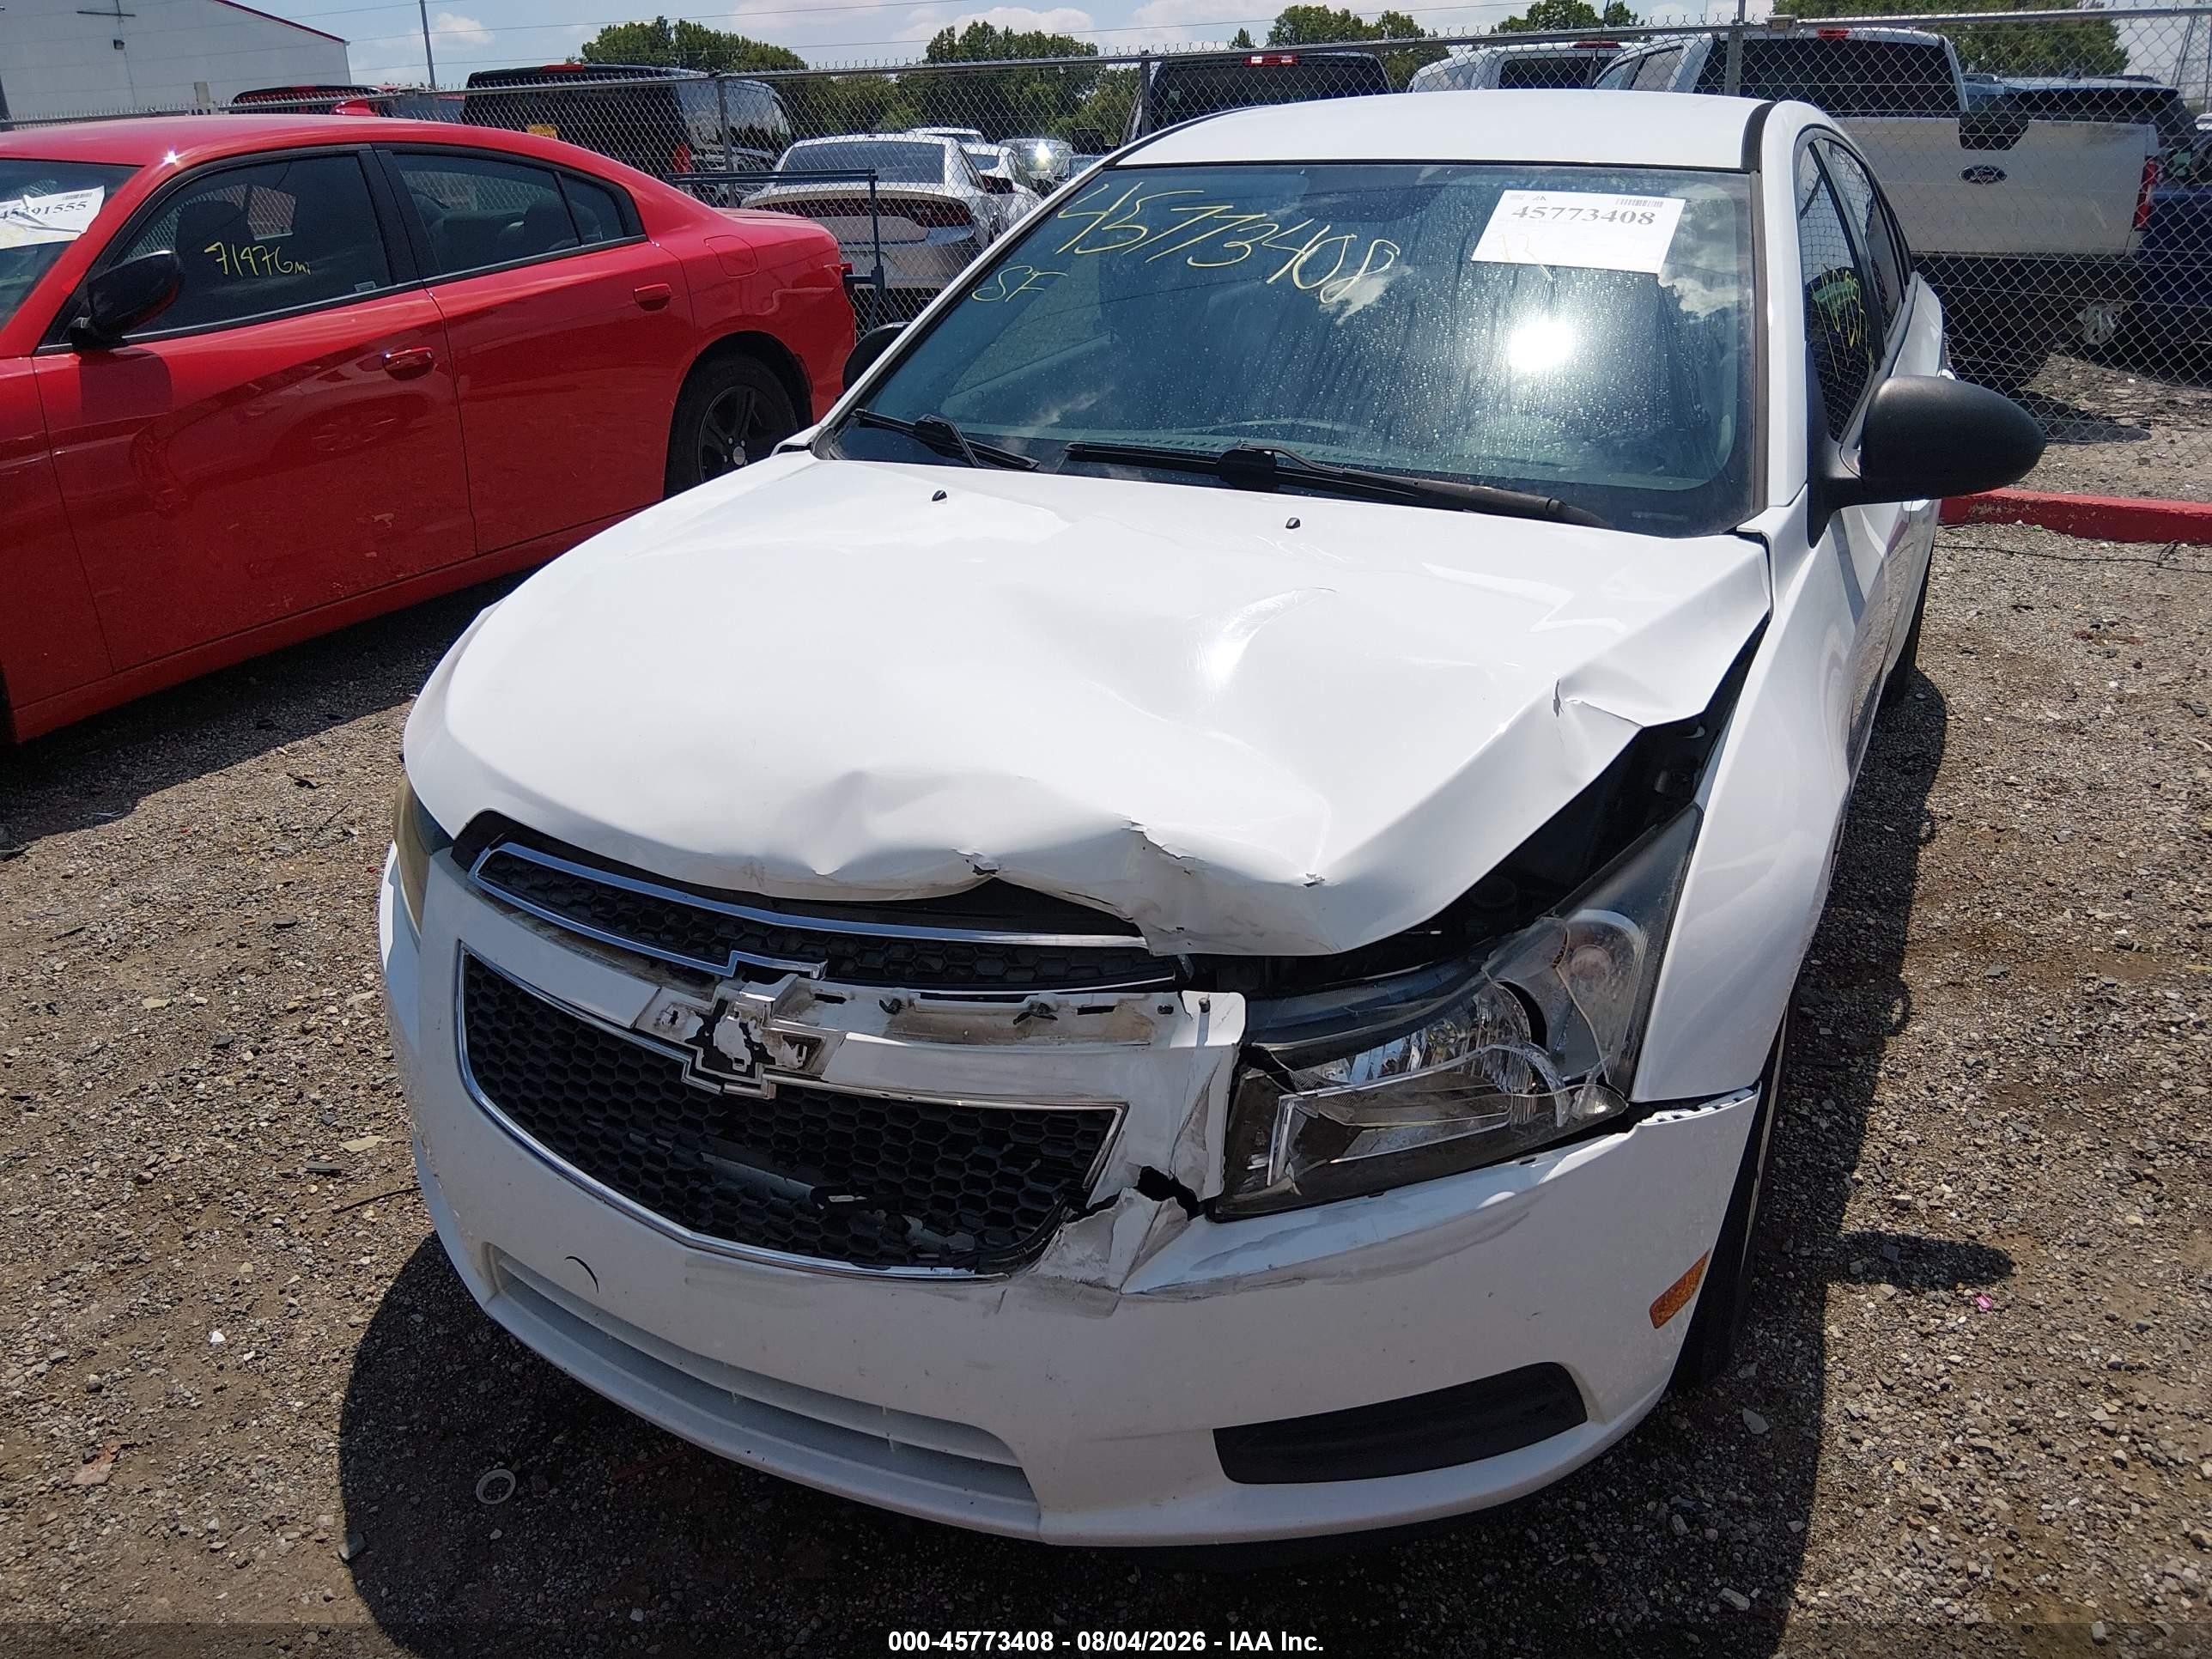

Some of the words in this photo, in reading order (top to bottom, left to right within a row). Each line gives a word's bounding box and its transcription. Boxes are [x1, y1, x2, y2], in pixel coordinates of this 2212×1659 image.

[1511, 205, 1656, 225] 45773408
[1056, 181, 1401, 304] 45773408
[971, 264, 1068, 302] SF
